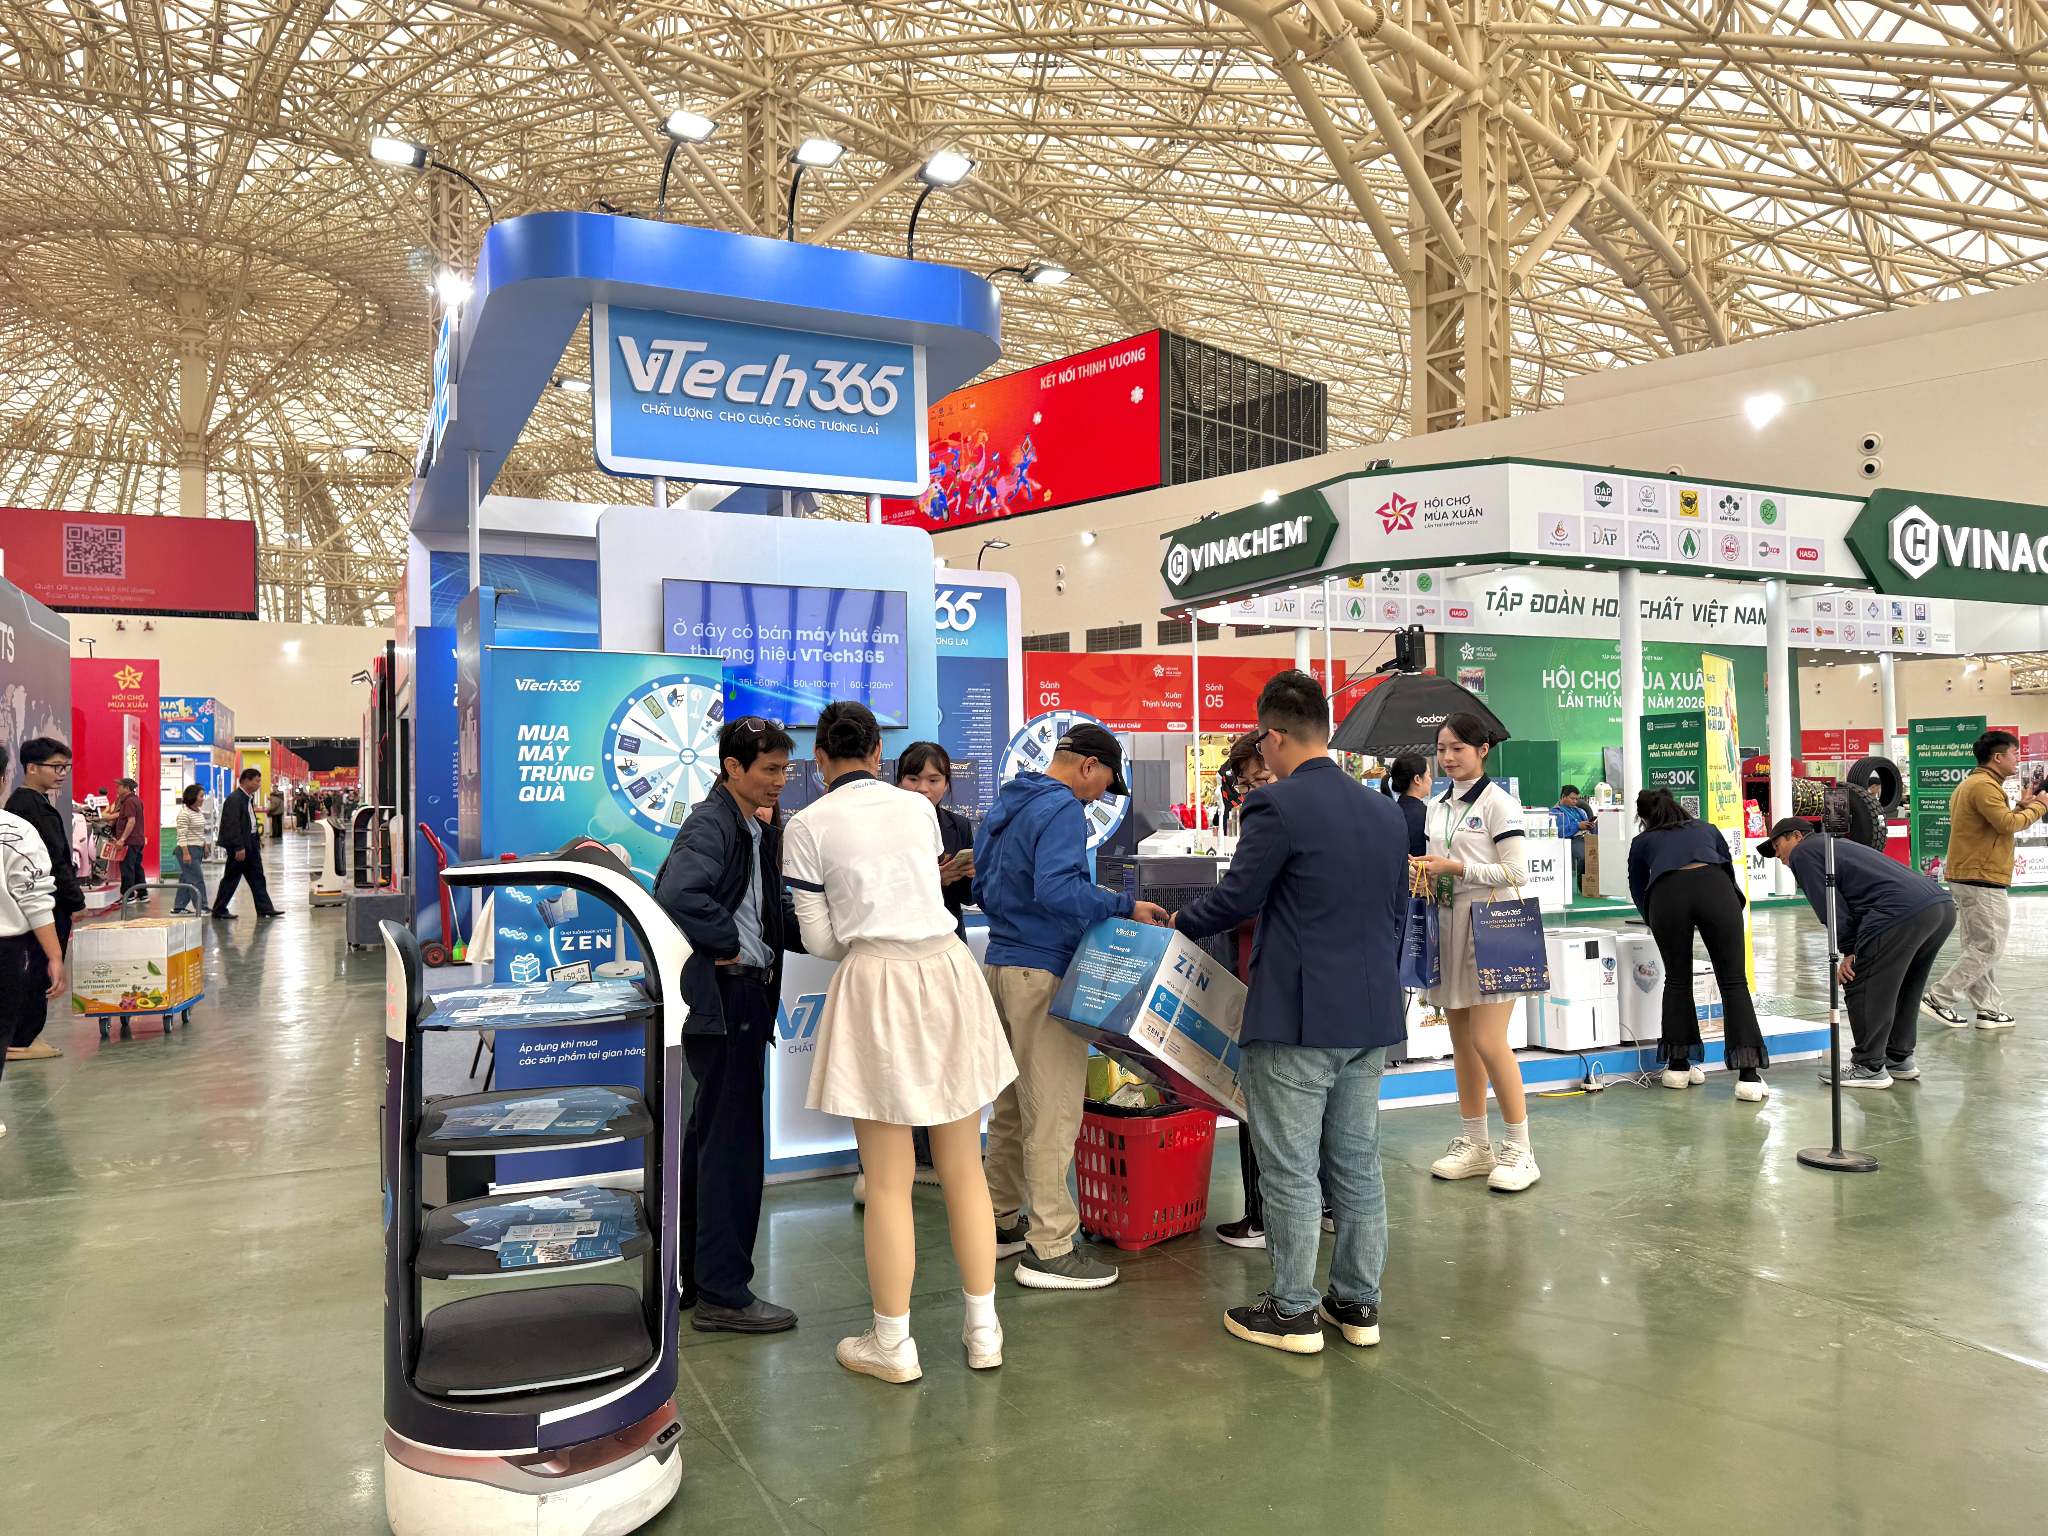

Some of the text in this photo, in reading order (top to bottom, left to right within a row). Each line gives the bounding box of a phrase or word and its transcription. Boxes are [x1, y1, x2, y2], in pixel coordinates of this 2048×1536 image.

[618, 336, 904, 416] VTech365
[1058, 365, 1076, 384] NỐI
[642, 401, 671, 416] CHẤT
[674, 407, 712, 422] LƯỢNG
[720, 412, 745, 423] CHO
[749, 412, 780, 427] CUỘC
[784, 414, 816, 430] SỐNG
[819, 420, 857, 434] TƯƠNG
[1596, 486, 1612, 496] DAP
[1424, 494, 1470, 510] HỘI CHỢ
[1452, 507, 1483, 519] XUÂN
[1191, 516, 1307, 571] VINACHEM
[1593, 525, 1618, 546] DAP
[935, 589, 982, 632] 65
[1486, 586, 1523, 616] TẬP
[1530, 590, 1585, 616] ĐOÀN
[1592, 598, 1620, 617] HO
[1692, 600, 1728, 628] VIỆT
[692, 623, 726, 642] đây
[732, 624, 753, 639] có
[758, 625, 792, 640] bán
[796, 628, 836, 646] máy
[840, 628, 868, 642] hút
[872, 626, 899, 644] ẩm
[760, 646, 796, 664] hiệu
[800, 648, 884, 664] VTech365
[516, 678, 582, 692] VTech365
[1542, 664, 1576, 694] HỘI
[1580, 669, 1621, 694] CHỢ
[1643, 666, 1666, 690] ÙA
[1670, 668, 1704, 691] XUÂ
[1040, 693, 1060, 706] 05
[1206, 694, 1224, 708] 05
[1558, 690, 1583, 708] LẦN
[1587, 692, 1612, 708] THỨ
[1648, 692, 1674, 708] NĂM
[1676, 696, 1704, 708] 2026
[518, 724, 570, 740] MUA
[518, 741, 570, 762] MÁY
[519, 762, 595, 782] TRÚNG
[1652, 770, 1695, 784] TẶNG 30K
[1921, 770, 1940, 778] TẶNG
[518, 782, 566, 802] QUÀ
[561, 934, 612, 952] ZEN
[1174, 954, 1210, 992] ZEN
[520, 1042, 532, 1054] Áp
[534, 1042, 559, 1052] dụng
[560, 1040, 575, 1049] khi
[520, 1047, 646, 1066] các sản phẩm tại gian hàng
